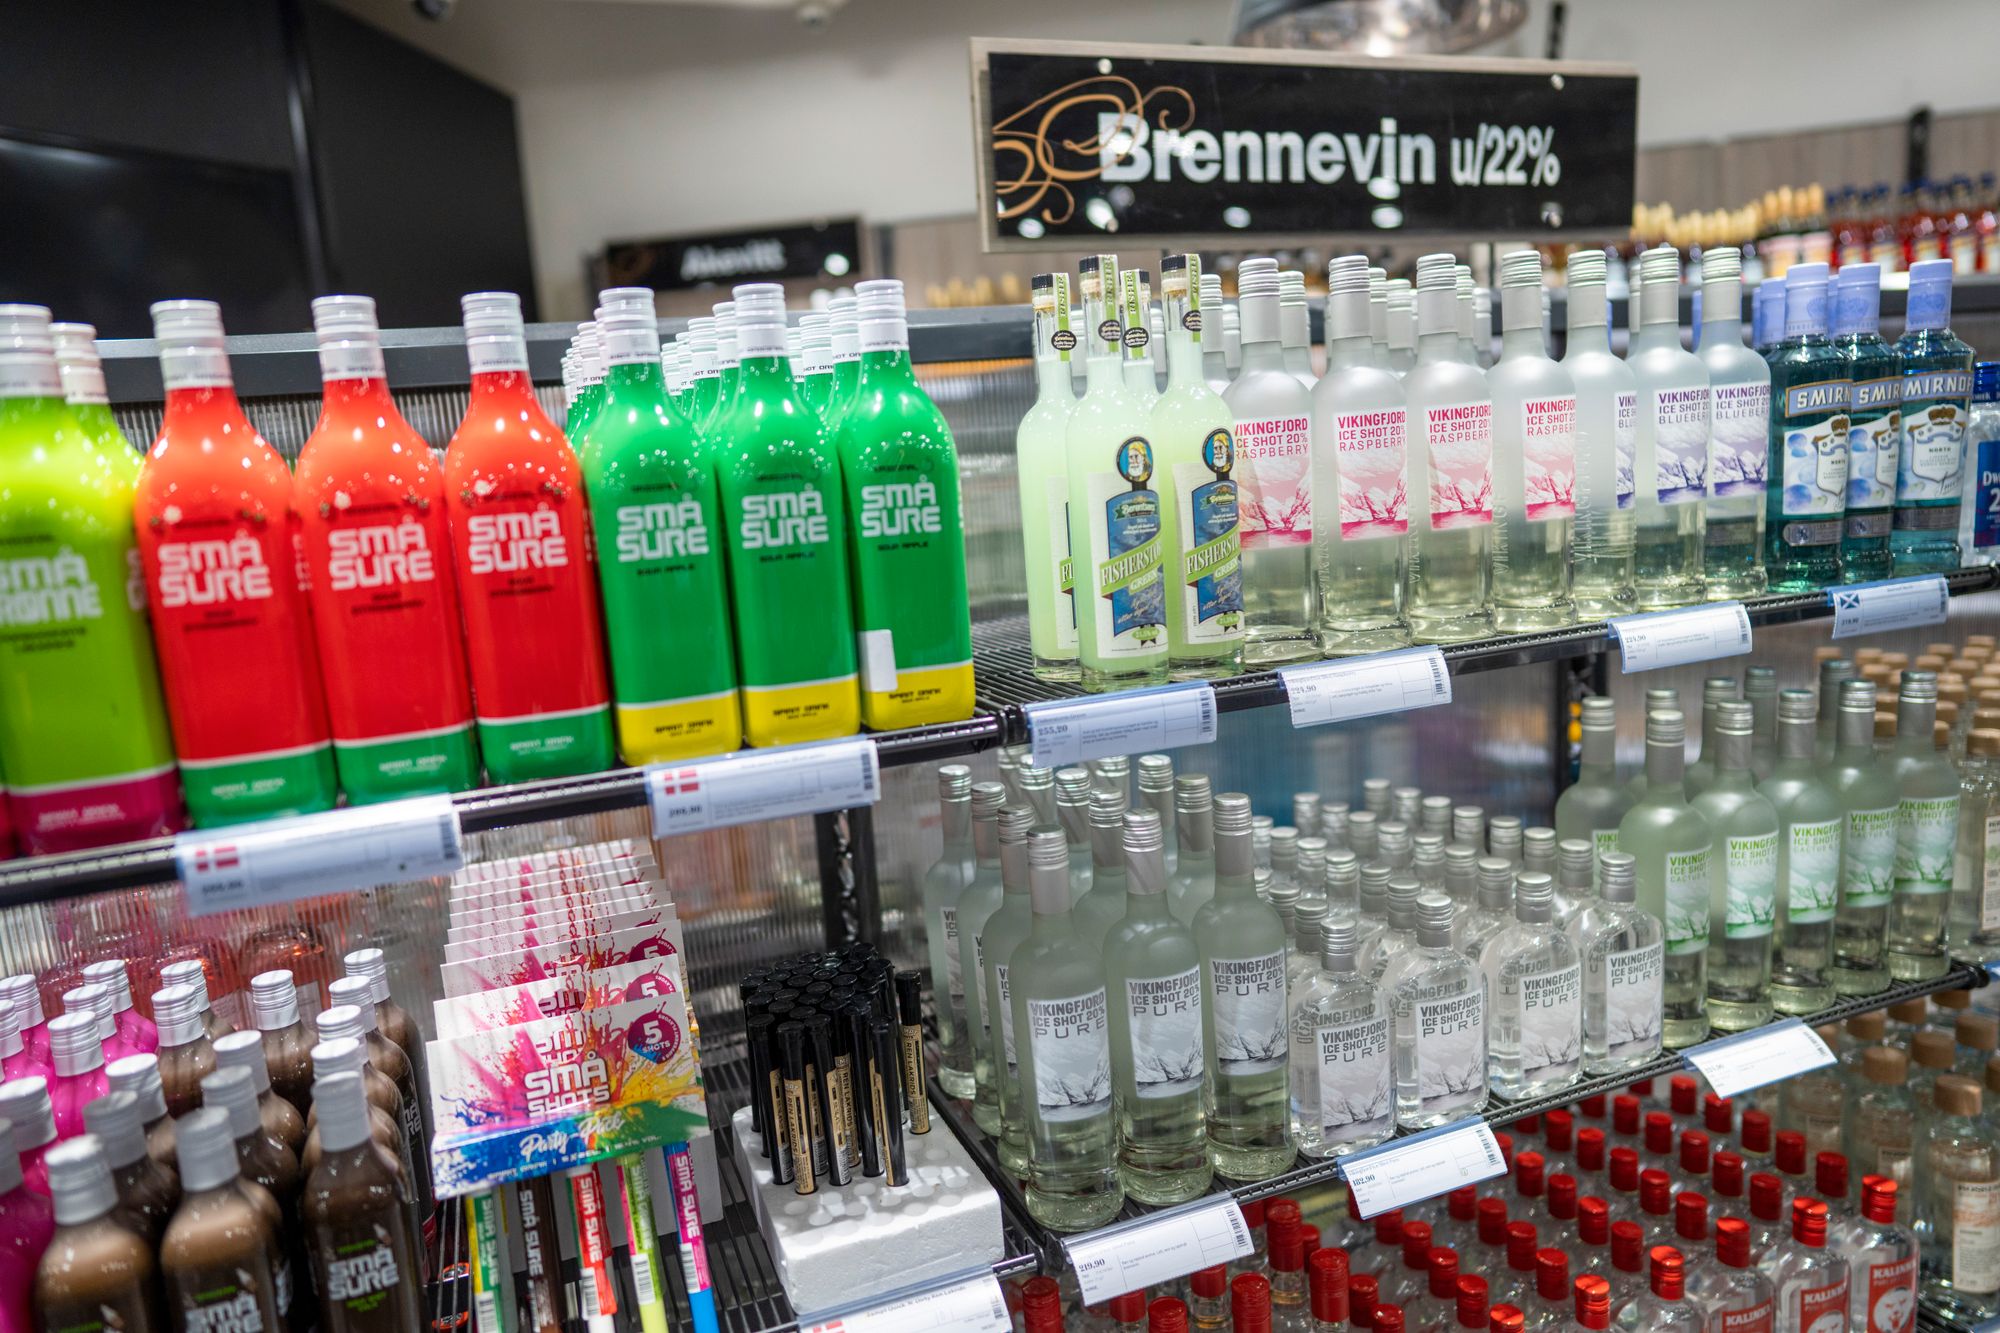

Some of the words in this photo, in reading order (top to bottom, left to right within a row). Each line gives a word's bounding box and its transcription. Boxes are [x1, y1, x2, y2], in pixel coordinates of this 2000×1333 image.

[1098, 112, 1436, 184] Brennevin
[1449, 122, 1560, 187] u/22%
[1527, 415, 1544, 425] ICE
[1547, 413, 1568, 424] SHOT
[1659, 405, 1676, 414] ICE
[1679, 402, 1700, 413] SHOT
[1339, 429, 1356, 440] ICE
[1360, 427, 1388, 438] SHOT
[1430, 422, 1447, 433] ICE
[1451, 420, 1476, 431] SHOT
[1253, 435, 1283, 447] SHOT
[1287, 432, 1308, 444] 20%
[741, 483, 823, 521] SMÅ
[861, 474, 937, 510] SMÅ
[468, 501, 561, 544] SMÅ
[616, 492, 703, 532] SMÅ
[861, 506, 942, 538] SURE
[329, 514, 427, 558] SMÅ
[616, 525, 710, 563] SURE
[741, 515, 829, 549] SURE
[158, 530, 265, 572] SMÅ
[468, 536, 568, 574] SURE
[329, 548, 435, 591] SURE
[158, 566, 274, 608] SURE
[1215, 974, 1232, 985] ICE
[1234, 973, 1264, 985] SHOT
[1524, 967, 1580, 991] VIKINGFJORD
[1611, 968, 1626, 977] ICE
[1628, 962, 1648, 974] SHOT
[1612, 965, 1660, 988] PURE
[1216, 976, 1283, 996] PURE
[1525, 991, 1540, 1000] ICE
[1542, 986, 1564, 997] SHOT
[1030, 991, 1104, 1016] VIKINGFJORD
[1131, 995, 1150, 1006] ICE
[1152, 991, 1181, 1005] SHOT
[1133, 994, 1199, 1017] PURE
[1420, 993, 1481, 1017] VIKINGFJORD
[1526, 989, 1579, 1010] PURE
[1033, 1016, 1050, 1027] ICE
[1053, 1013, 1083, 1027] SHOT
[1035, 1016, 1105, 1039] PURE
[1422, 1017, 1438, 1027] ICE
[1440, 1011, 1464, 1024] SHOT
[1466, 1005, 1481, 1018] 20%
[1423, 1015, 1480, 1038] PURE
[642, 1020, 663, 1045] 5
[1321, 1019, 1387, 1044] VIKINGFJORD
[1323, 1044, 1340, 1054] ICE
[1343, 1038, 1368, 1052] SHOT
[1370, 1031, 1387, 1045] 20%
[642, 1040, 671, 1053] SHOTS
[1325, 1041, 1386, 1065] PURE
[524, 1050, 608, 1099] SMÅ
[907, 1060, 916, 1096] LAKRIDS
[844, 1090, 853, 1127] LAKRIDS
[682, 1195, 701, 1239] SURE
[585, 1217, 603, 1264] SURE
[525, 1231, 544, 1276] SURE
[1078, 1258, 1106, 1273] 219,90
[329, 1263, 399, 1301] SURE
